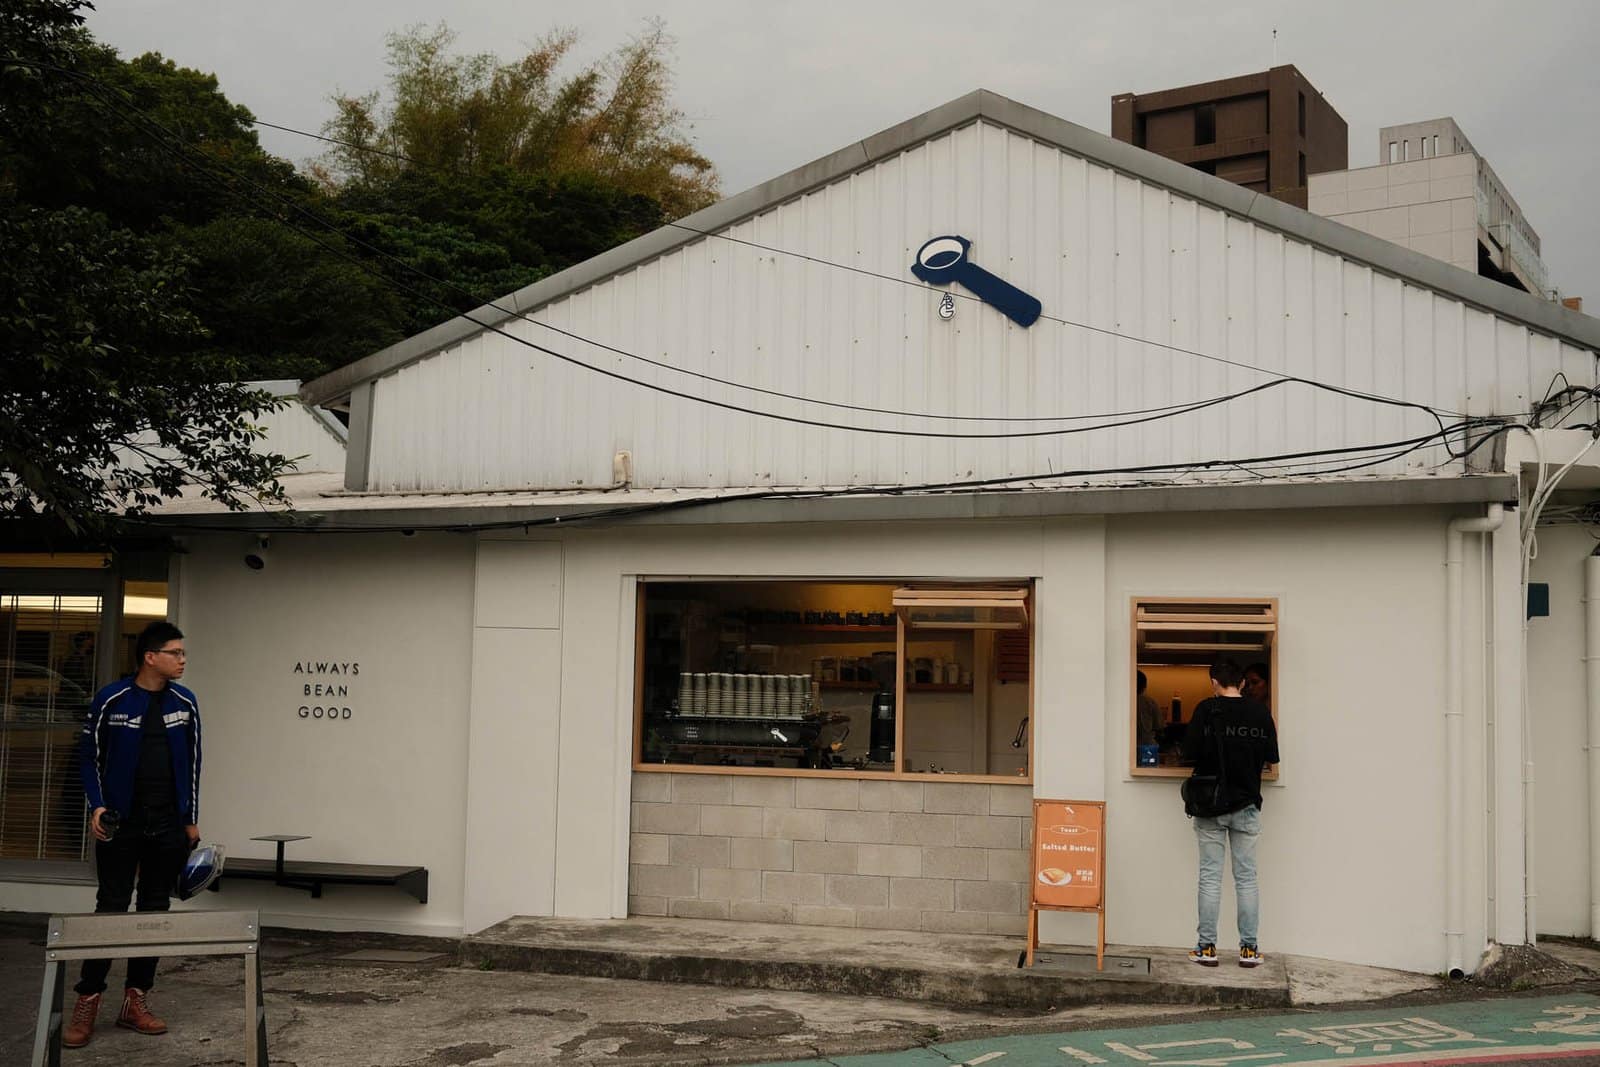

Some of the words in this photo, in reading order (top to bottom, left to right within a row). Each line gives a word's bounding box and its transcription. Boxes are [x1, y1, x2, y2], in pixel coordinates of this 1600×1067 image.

[294, 661, 360, 675] ALWAYS
[303, 683, 348, 697] BEAN
[298, 705, 352, 720] GOOD
[1203, 725, 1268, 739] KNGOL
[1069, 844, 1095, 852] Butter
